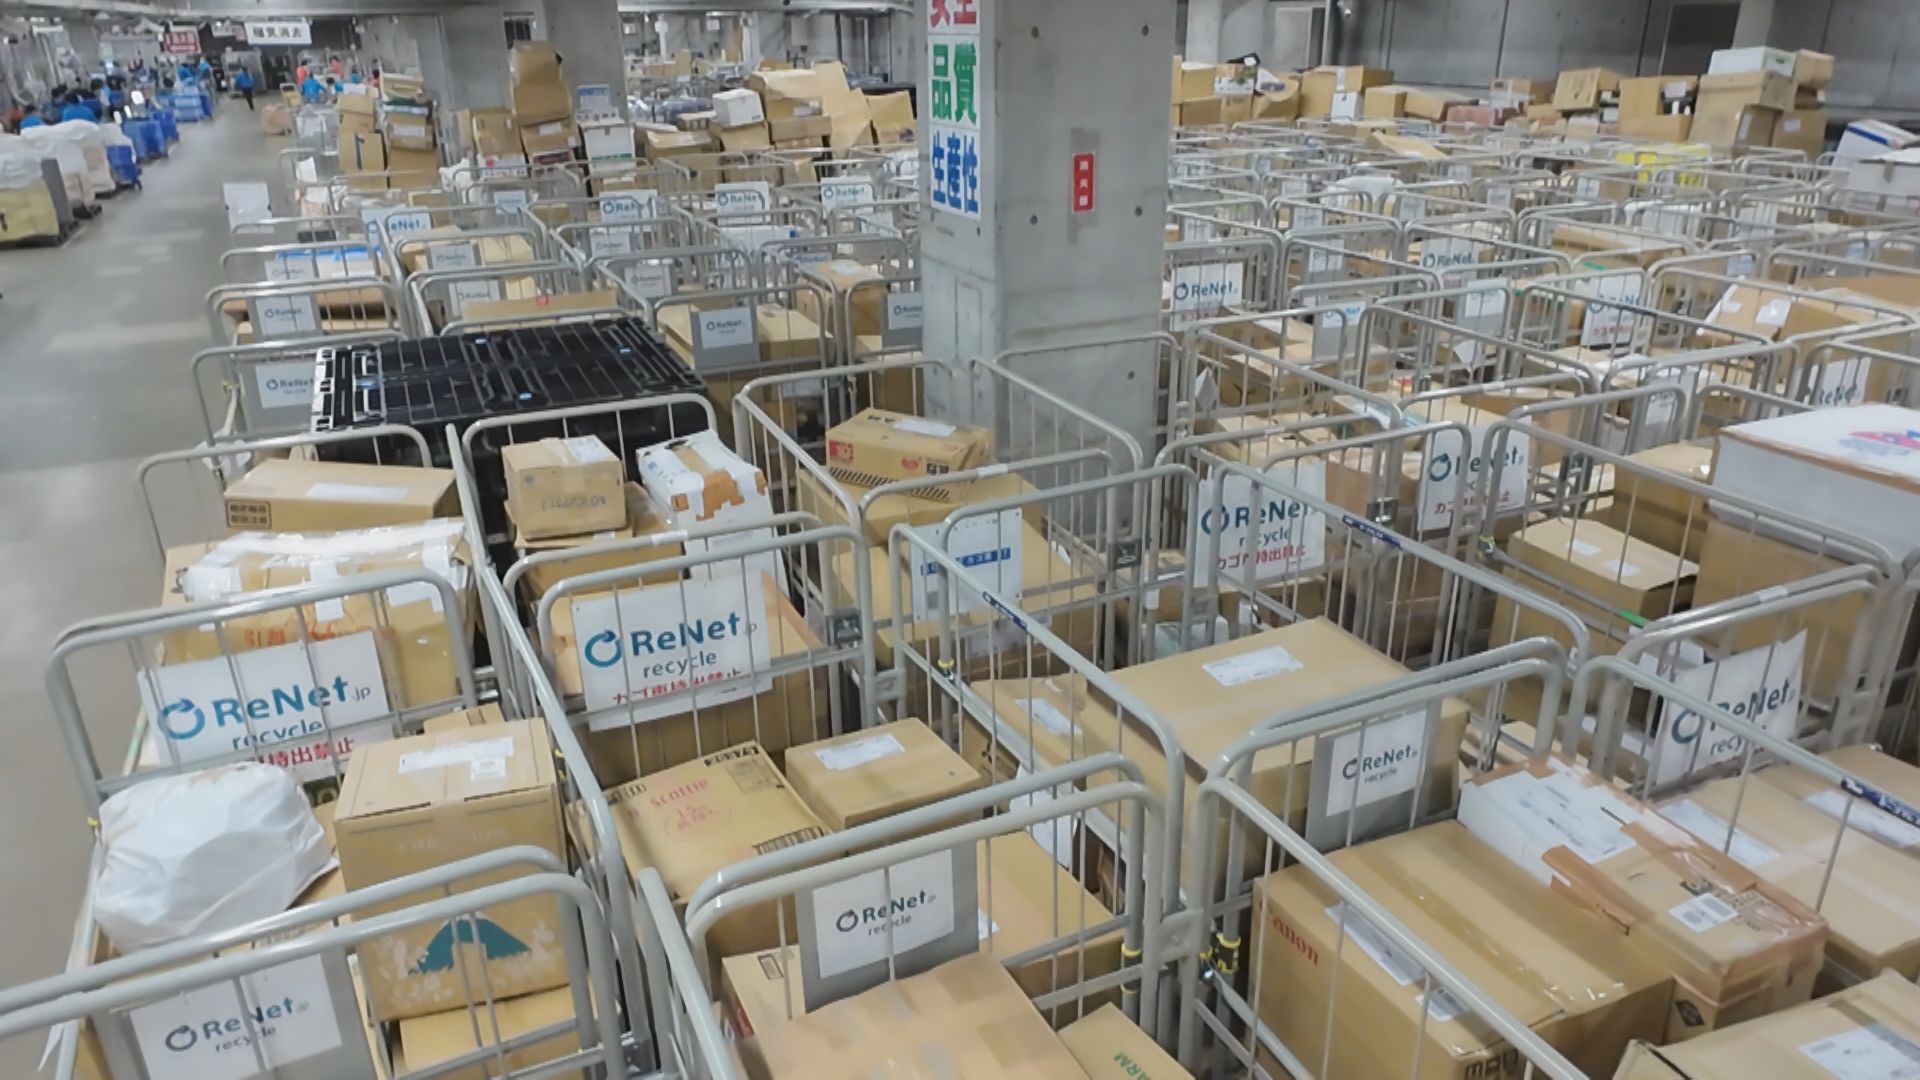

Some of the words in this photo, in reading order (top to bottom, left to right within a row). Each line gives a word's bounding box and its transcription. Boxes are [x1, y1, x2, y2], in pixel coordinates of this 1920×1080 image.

[931, 43, 977, 125] 品質
[932, 129, 979, 214] 生産性
[631, 611, 740, 657] ReNet
[643, 651, 717, 678] recycle
[211, 675, 348, 728] ReNet
[1362, 744, 1411, 772] ReNet
[862, 889, 926, 924] ReNet
[202, 997, 294, 1040] ReNet
